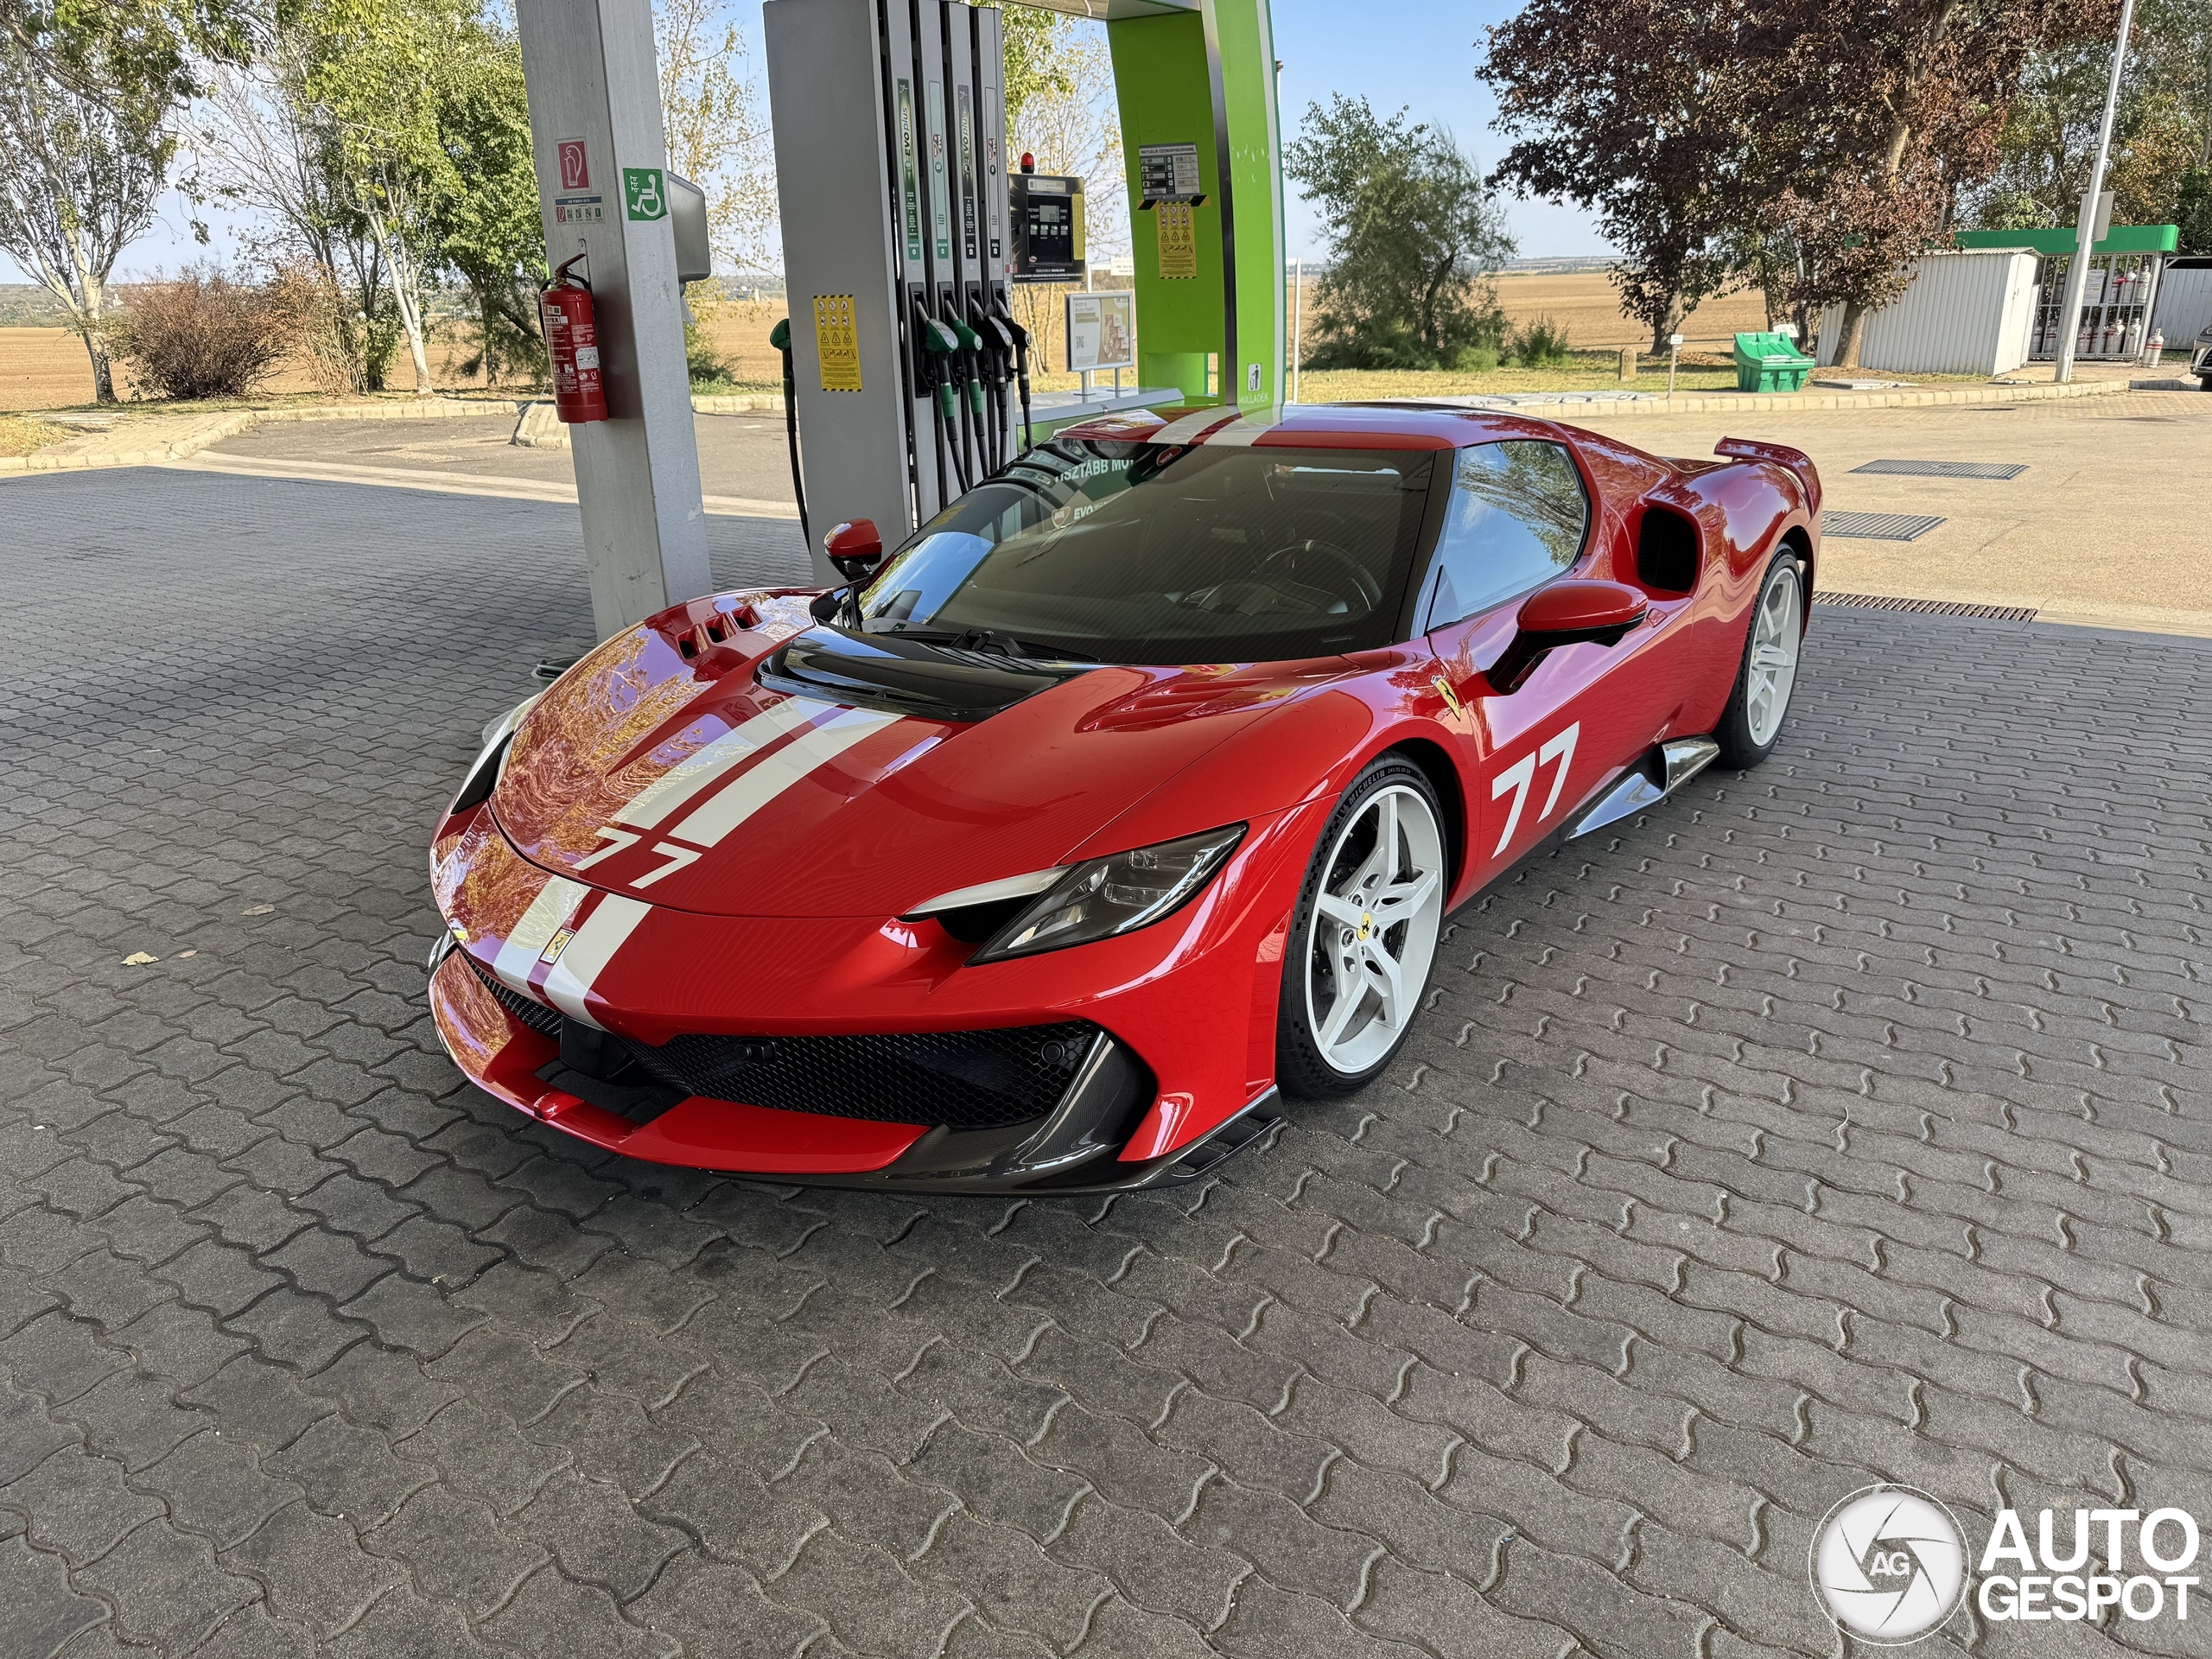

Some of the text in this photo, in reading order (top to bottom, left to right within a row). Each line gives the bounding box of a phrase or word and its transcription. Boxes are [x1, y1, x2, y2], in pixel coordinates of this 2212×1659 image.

[1238, 391, 1269, 404] HULLADÉK
[1349, 769, 1386, 805] MICHELIN
[1491, 720, 1580, 861] 77
[570, 825, 703, 890] 77
